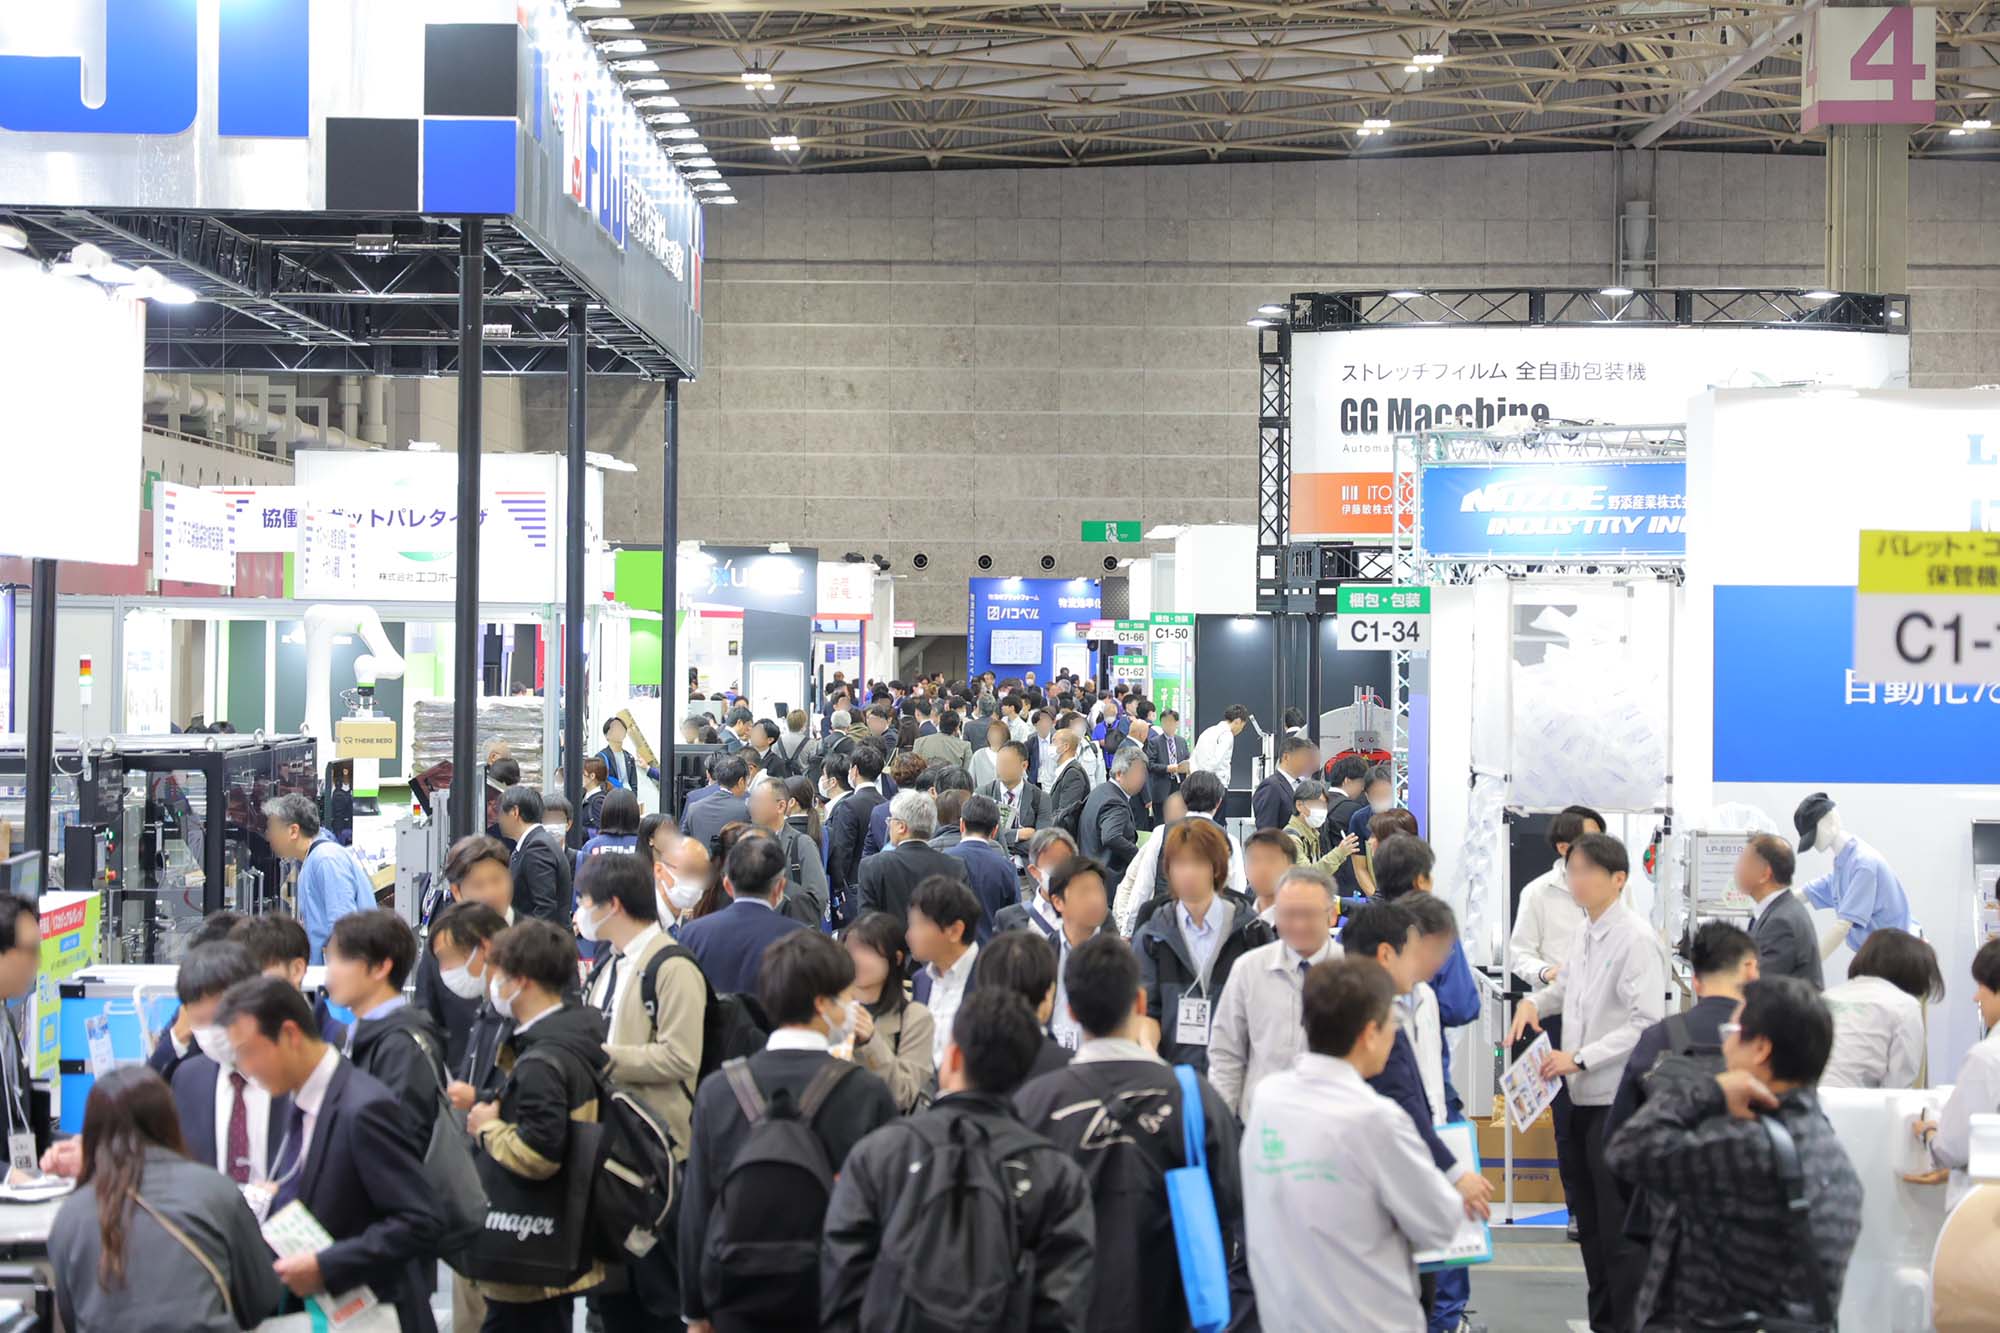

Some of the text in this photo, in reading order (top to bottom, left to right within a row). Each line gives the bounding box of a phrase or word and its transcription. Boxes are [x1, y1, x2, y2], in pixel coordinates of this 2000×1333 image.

[1850, 7, 1926, 101] 4
[1342, 360, 1647, 382] ストレッチフィルム 全自動包装機
[1340, 398, 1378, 436] GG
[1367, 485, 1393, 500] ITO
[1487, 516, 1645, 535] INDUSTRY
[1349, 592, 1421, 608] 梱包・包装
[1118, 632, 1144, 641] C1-66
[1155, 628, 1188, 639] C1-50
[1351, 620, 1420, 642] C1-34
[1118, 667, 1144, 677] C1-62
